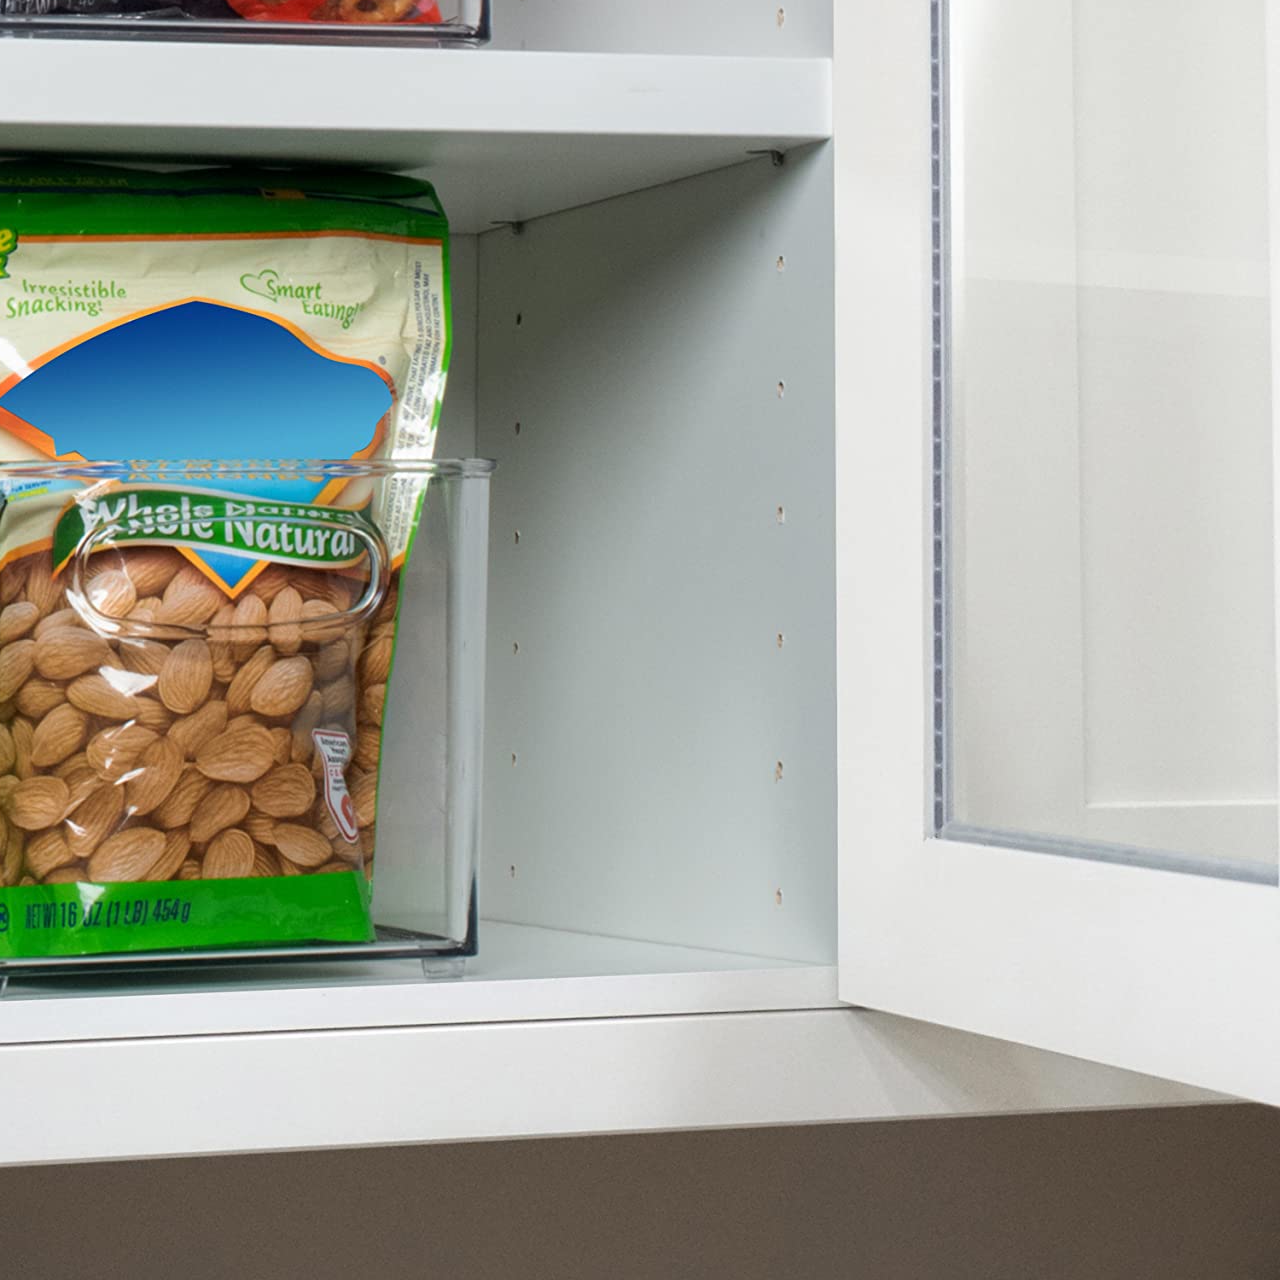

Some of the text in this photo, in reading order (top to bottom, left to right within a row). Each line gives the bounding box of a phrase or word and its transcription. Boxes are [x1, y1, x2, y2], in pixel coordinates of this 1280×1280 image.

[22, 279, 127, 299] Irresistible
[266, 278, 323, 300] Smart
[6, 295, 103, 319] Snacking!
[80, 492, 215, 541] Whole
[25, 903, 42, 929] NET
[42, 902, 57, 929] WT
[60, 901, 78, 929] 16
[82, 901, 104, 929] OZ
